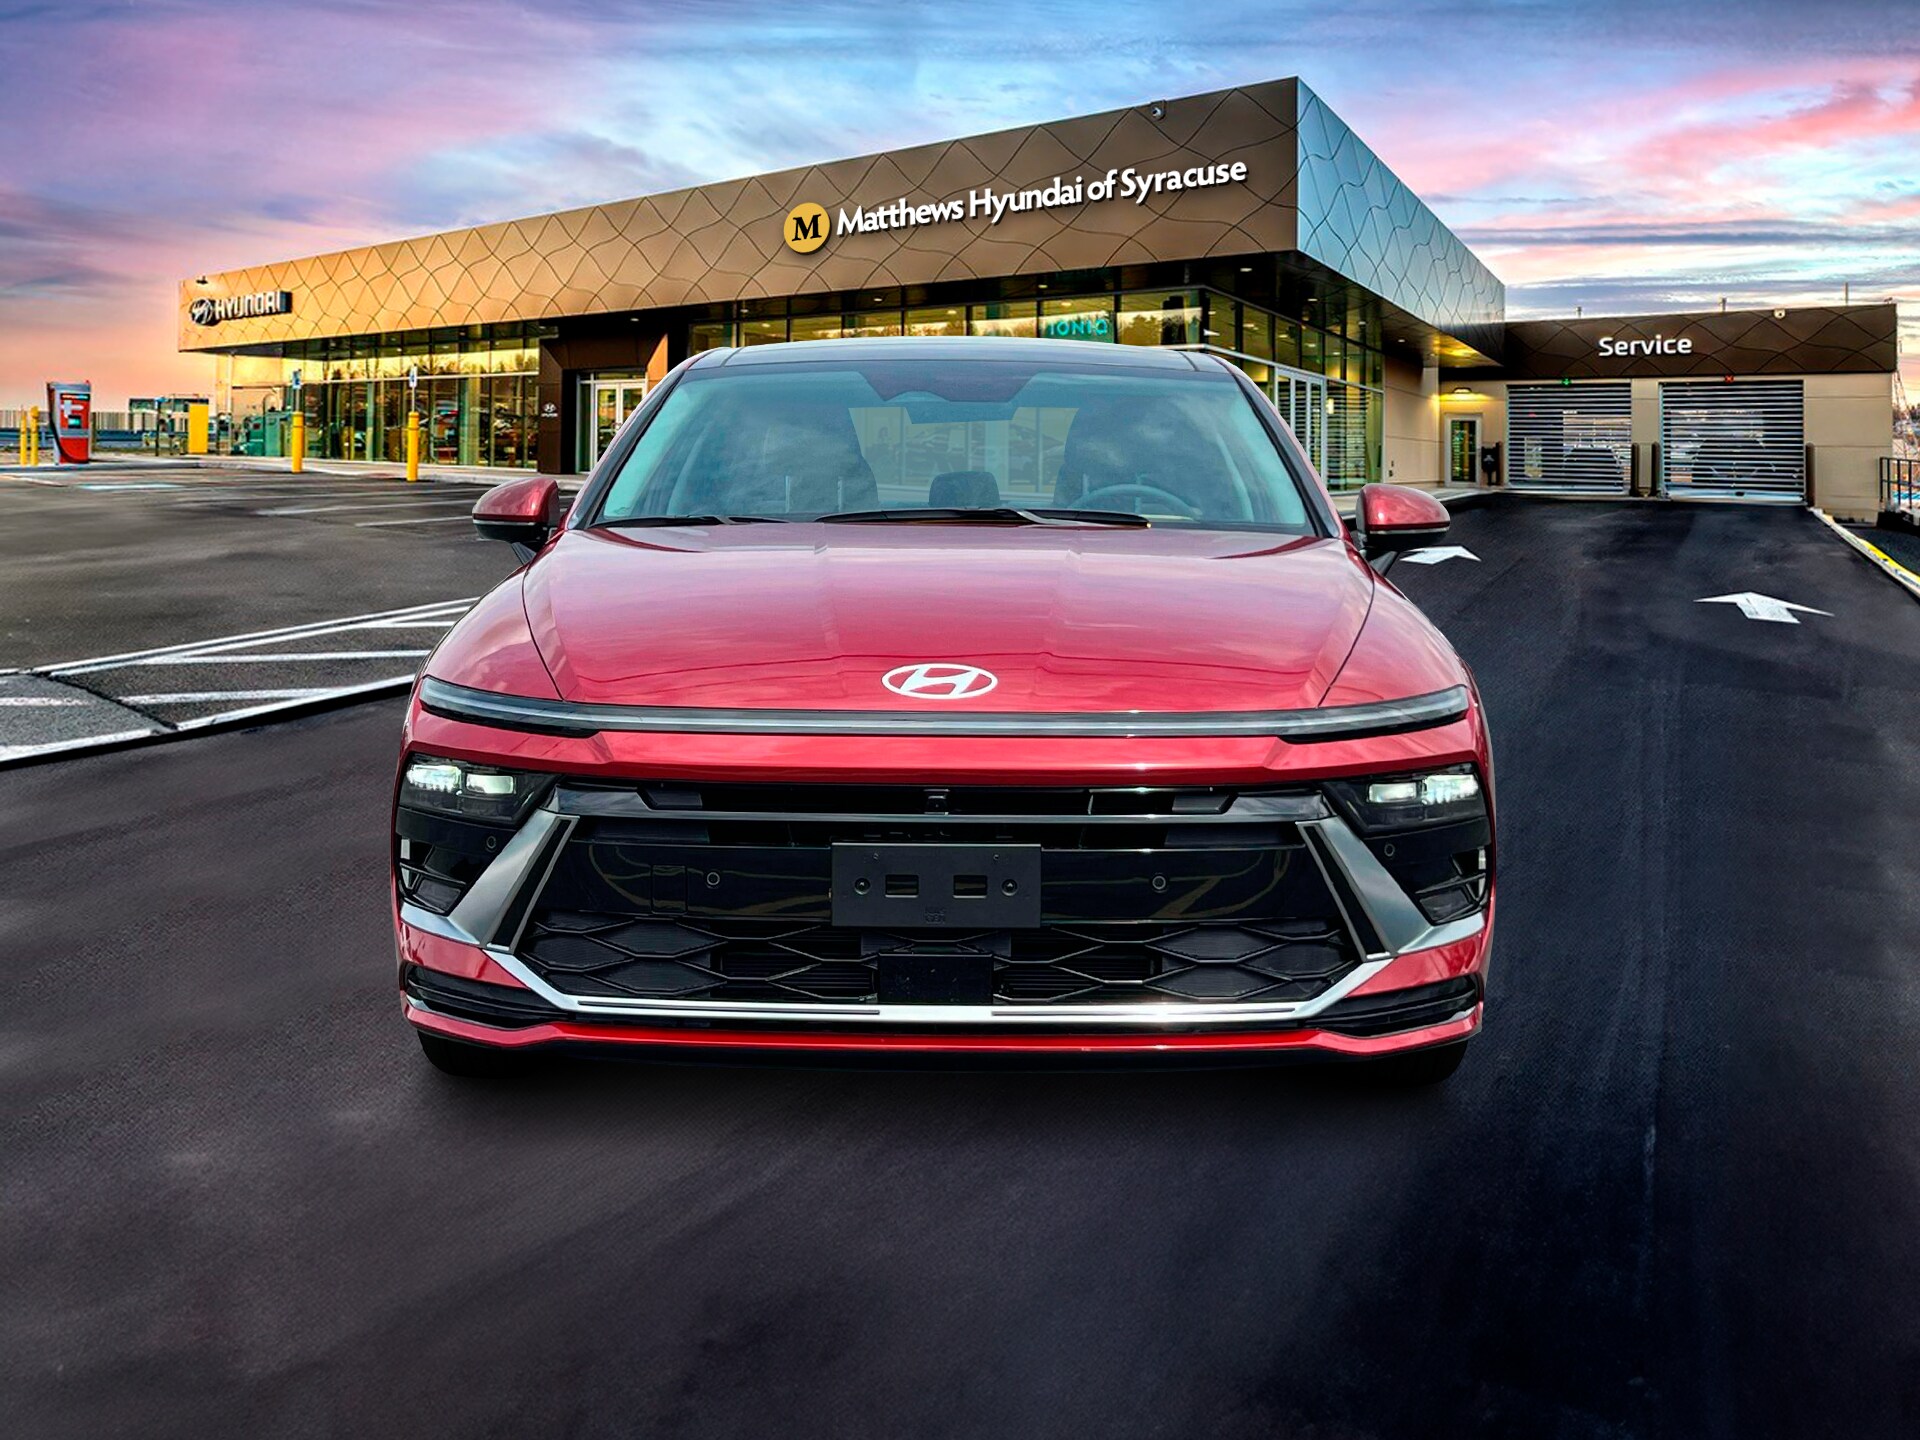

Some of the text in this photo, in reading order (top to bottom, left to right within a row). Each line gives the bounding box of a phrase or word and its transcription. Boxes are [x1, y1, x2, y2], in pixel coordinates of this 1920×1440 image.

[836, 161, 1247, 236] Matthews Hyundai of Syracuse
[791, 213, 822, 242] M
[214, 290, 281, 319] HYUNDAI
[1050, 318, 1108, 336] IONIQ
[1598, 334, 1693, 356] Service
